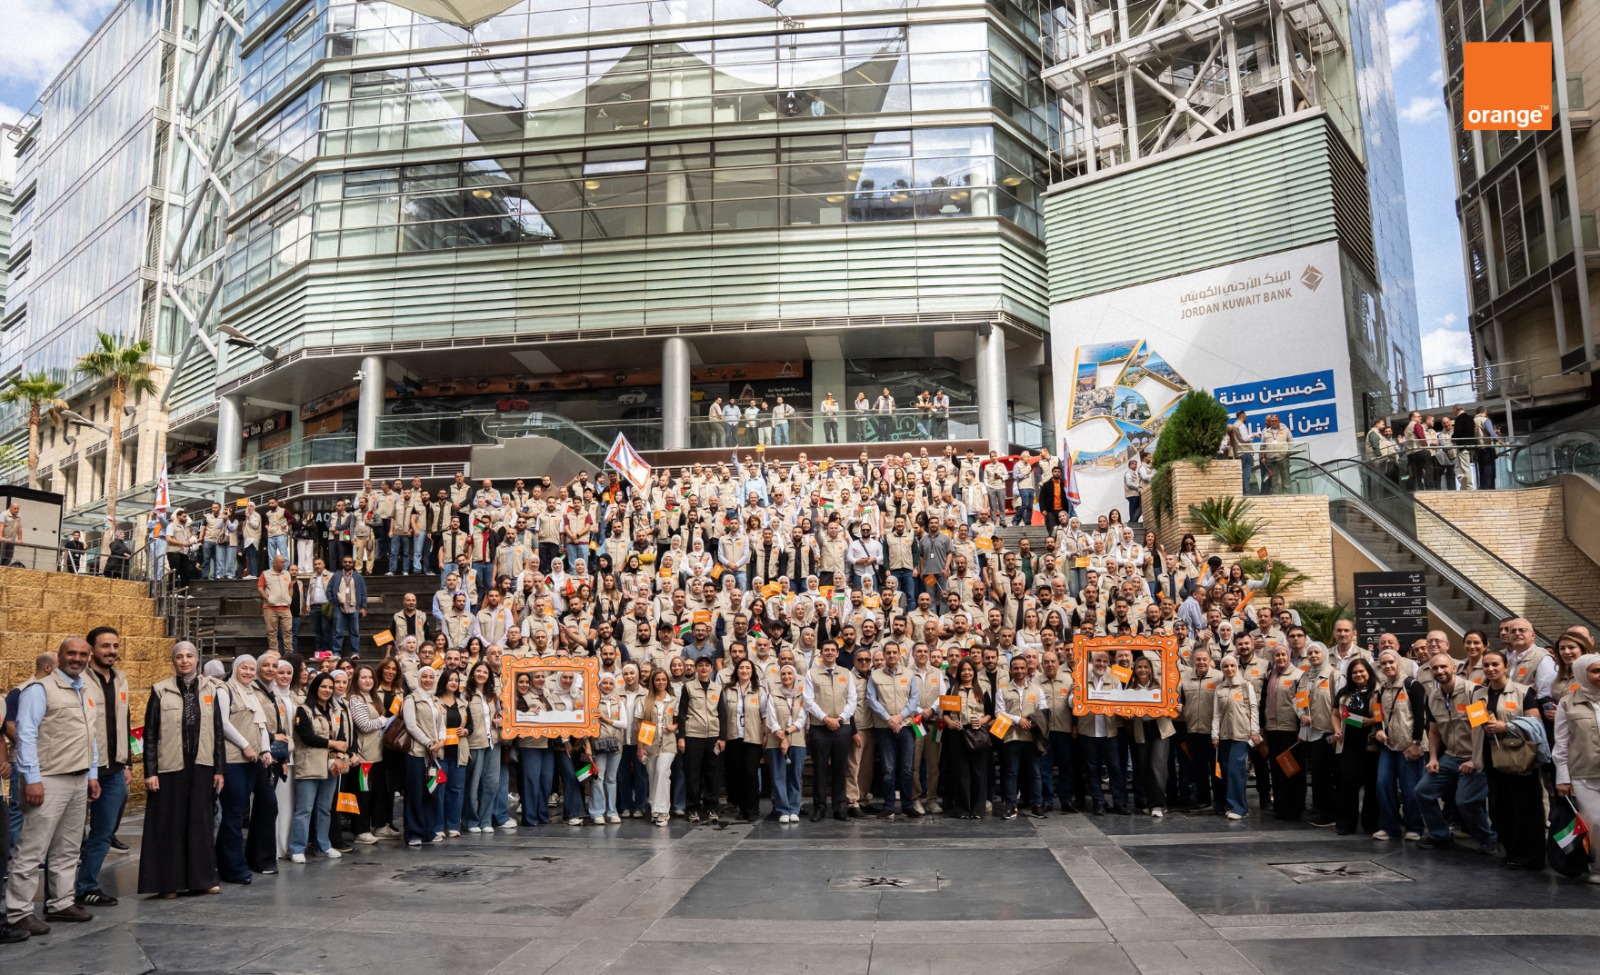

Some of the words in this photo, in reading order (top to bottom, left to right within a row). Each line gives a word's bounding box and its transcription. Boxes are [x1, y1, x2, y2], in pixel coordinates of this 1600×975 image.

[1262, 270, 1292, 286] البنك
[1180, 285, 1221, 305] الكويتي
[1181, 302, 1220, 319] JORDAN
[1222, 293, 1261, 311] KUWAIT
[1263, 287, 1293, 303] BANK
[1219, 391, 1255, 406] سنة
[1258, 378, 1327, 404] خمسين
[250, 424, 261, 436] Club
[1298, 415, 1330, 434] بين
